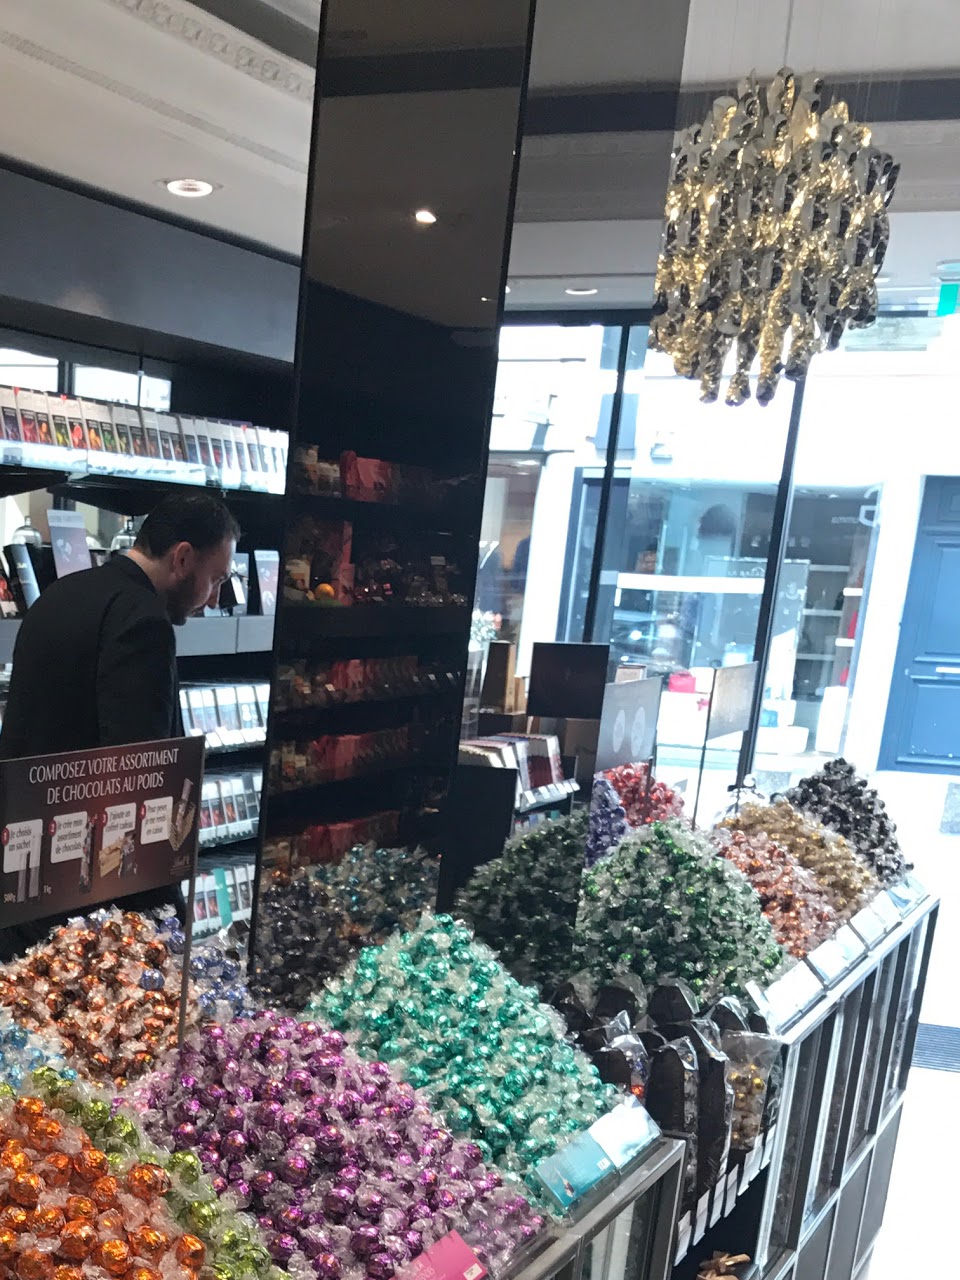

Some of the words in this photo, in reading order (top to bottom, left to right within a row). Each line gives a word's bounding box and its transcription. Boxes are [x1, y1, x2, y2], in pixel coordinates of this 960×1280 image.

[29, 759, 85, 784] COMPOSEZ
[87, 756, 118, 776] VOTRE
[119, 748, 179, 771] ASSORTIMENT
[47, 787, 60, 805] DE
[62, 777, 120, 802] CHOCOLATS
[122, 776, 136, 793] AU
[137, 771, 164, 790] POIDS
